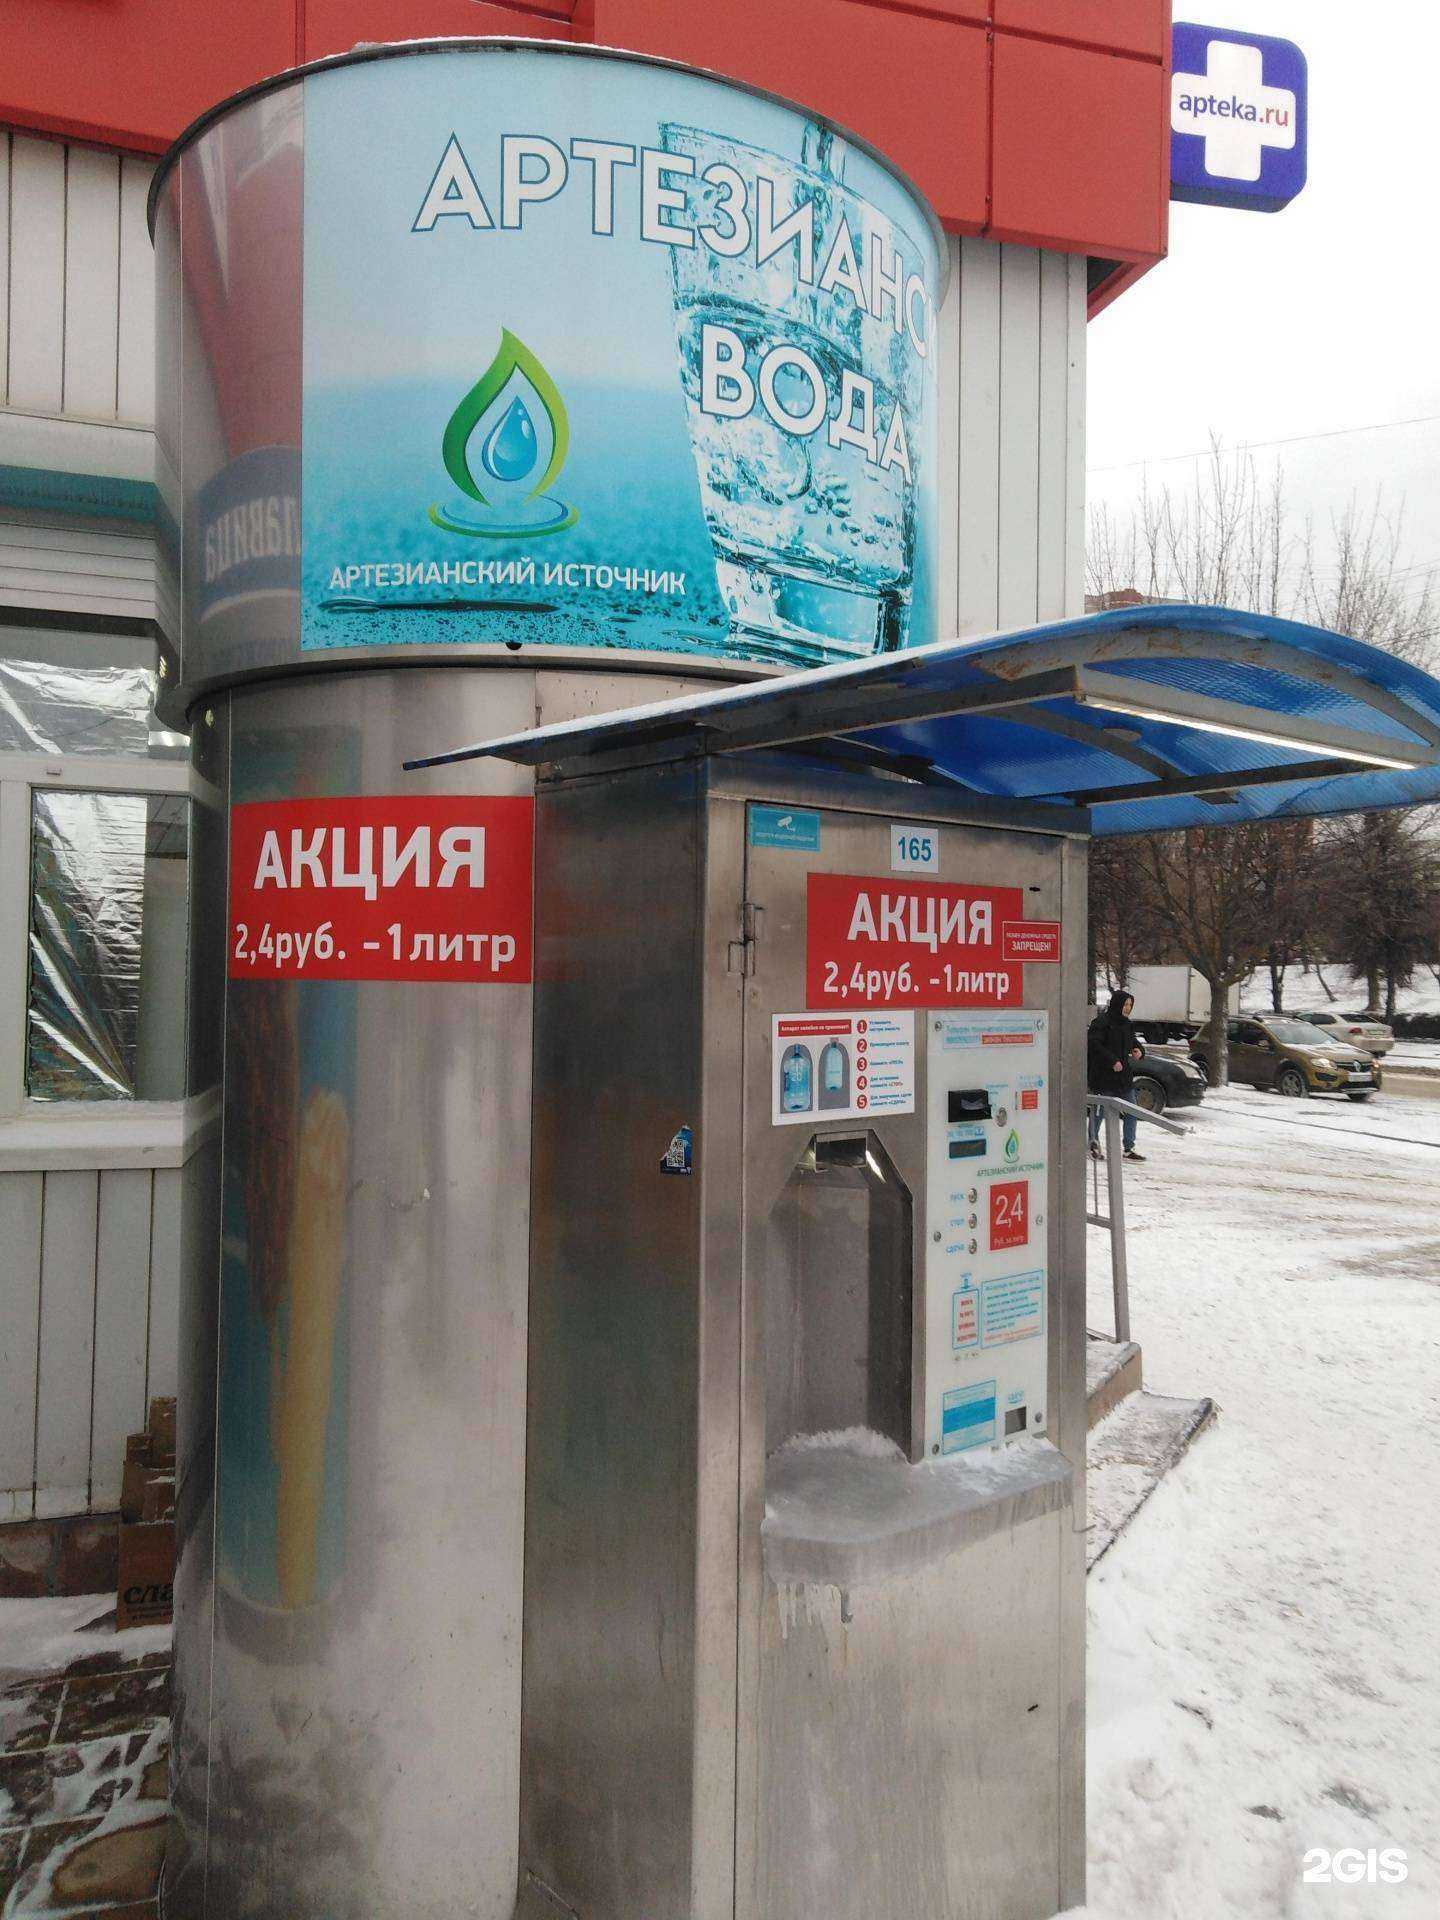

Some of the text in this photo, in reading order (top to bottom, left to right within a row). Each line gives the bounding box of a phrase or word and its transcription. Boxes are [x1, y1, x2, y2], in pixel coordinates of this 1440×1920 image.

[1179, 94, 1288, 126] apteka.ru
[700, 323, 912, 486] ВОДА
[329, 556, 686, 595] АРТЕЗИАНСКИЙ ИСТОЧНИК
[253, 826, 486, 900] АКЦИЯ
[897, 837, 932, 862] 165
[847, 893, 992, 953] АКЦИЯ
[858, 1040, 866, 1052] 2
[858, 1058, 866, 1070] 3
[858, 1077, 866, 1089] 4
[858, 1095, 866, 1107] 5
[995, 1192, 1023, 1228] 2,4
